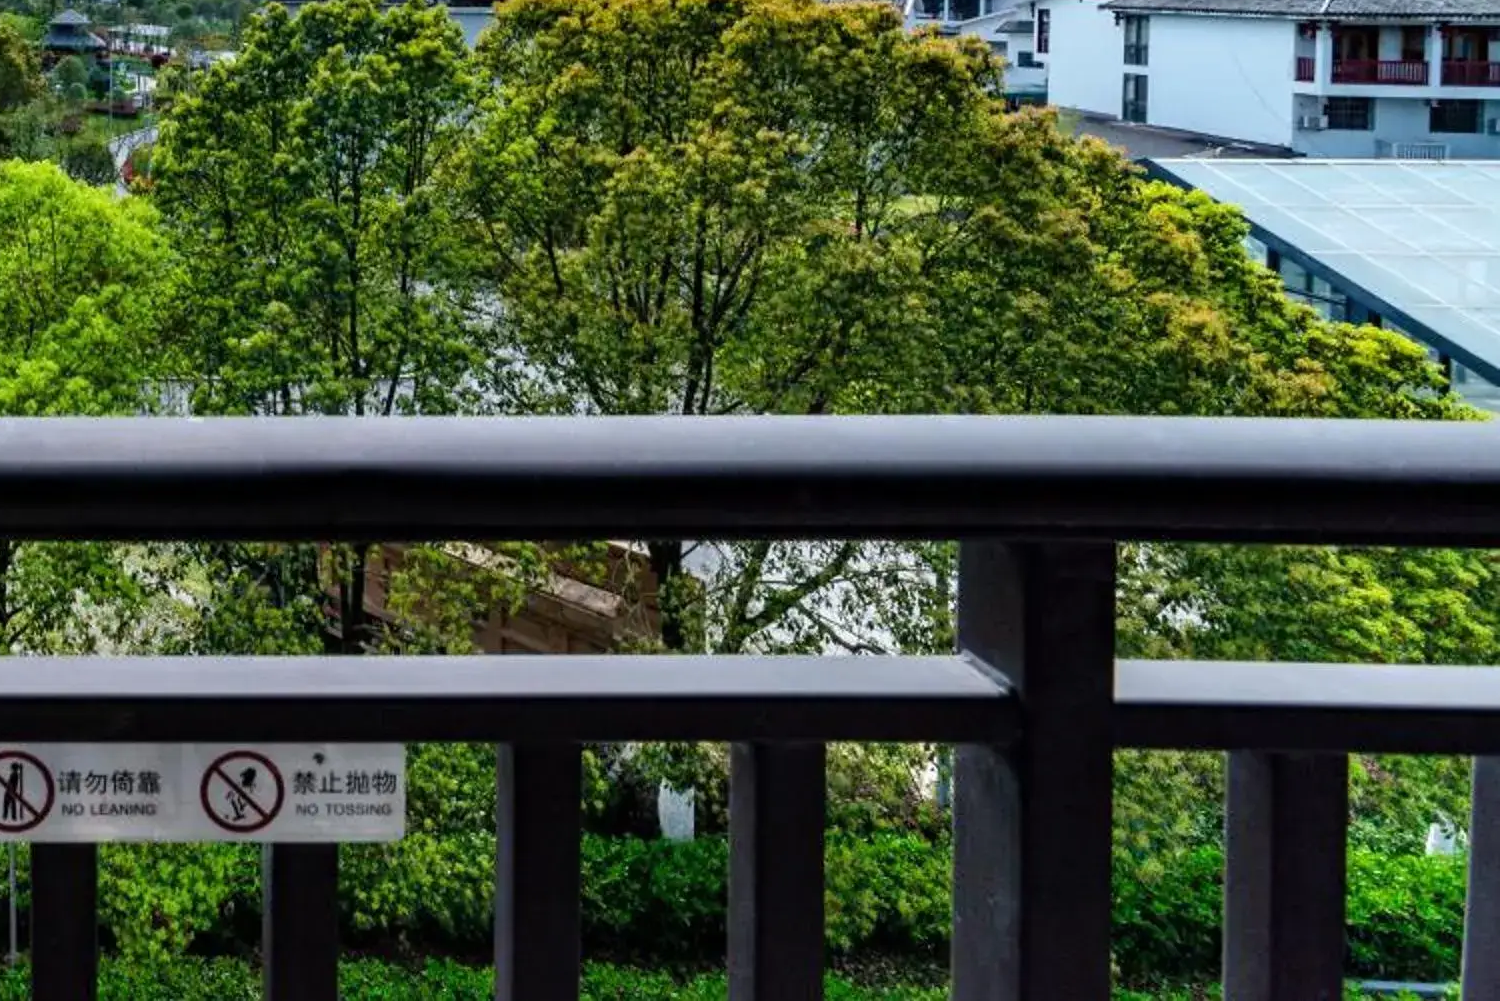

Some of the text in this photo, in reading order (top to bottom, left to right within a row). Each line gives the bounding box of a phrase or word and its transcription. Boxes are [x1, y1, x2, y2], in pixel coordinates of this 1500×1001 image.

[57, 768, 162, 795] 请勿倚靠
[293, 768, 397, 795] 禁止抛物
[61, 802, 157, 817] NO LEANING
[295, 802, 393, 817] NO TOSSING
